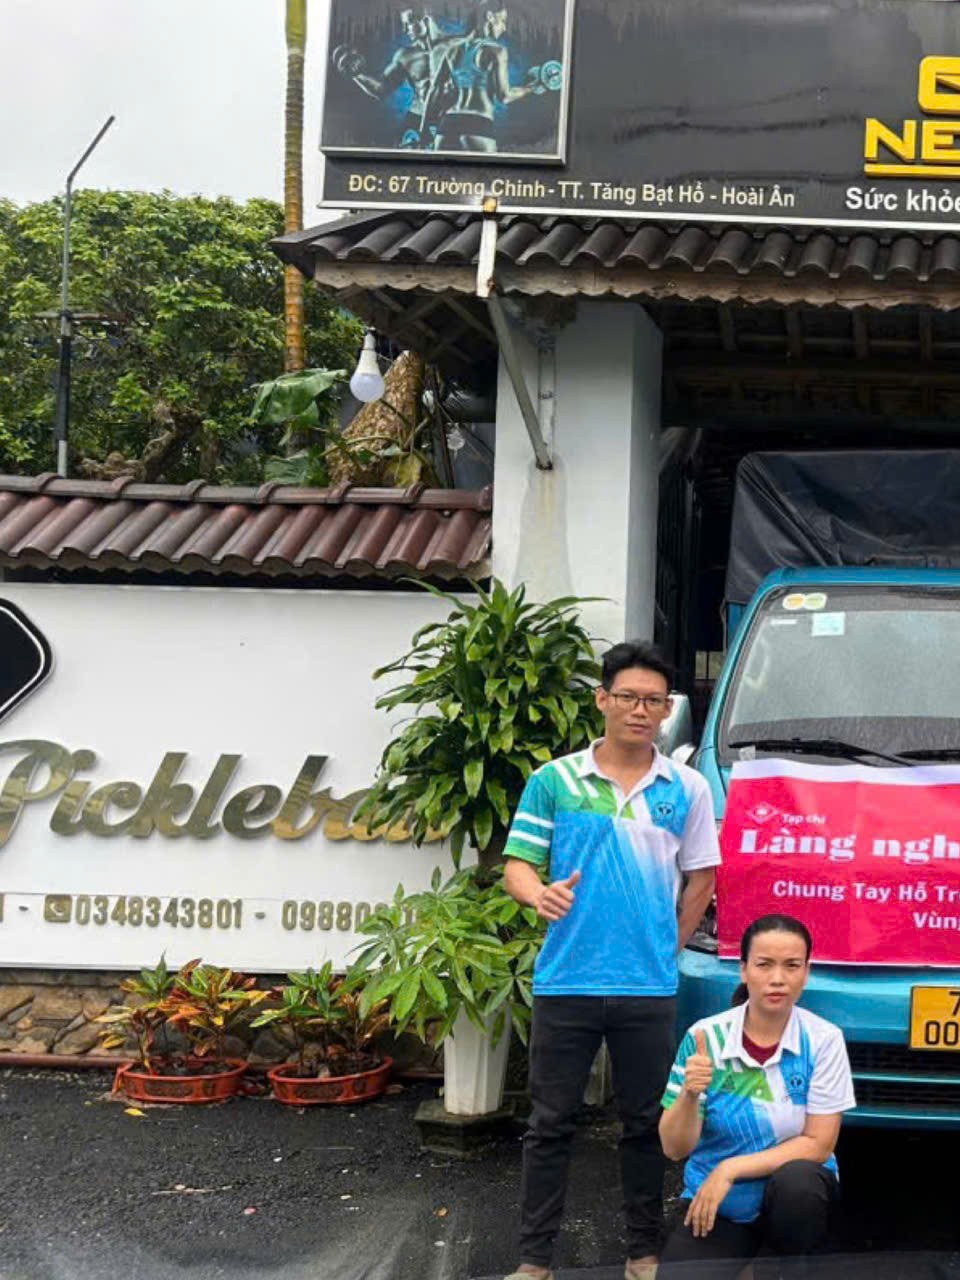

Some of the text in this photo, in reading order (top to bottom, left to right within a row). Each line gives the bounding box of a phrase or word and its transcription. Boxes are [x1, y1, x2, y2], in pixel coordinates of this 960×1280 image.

[349, 174, 383, 192] ĐC:
[388, 175, 411, 193] 67
[416, 175, 486, 198] Trường
[491, 178, 545, 198] Chinh
[557, 180, 584, 199] TT.
[591, 182, 637, 205] Tăng
[642, 183, 673, 206] Bạt
[722, 186, 764, 206] Hoài
[768, 184, 795, 207] Ân
[846, 187, 898, 211] Sức
[740, 828, 857, 862] Làng
[773, 880, 845, 901] Chung
[852, 882, 891, 903] Tay
[899, 880, 927, 902] Hỗ
[75, 894, 243, 929] 0348343801
